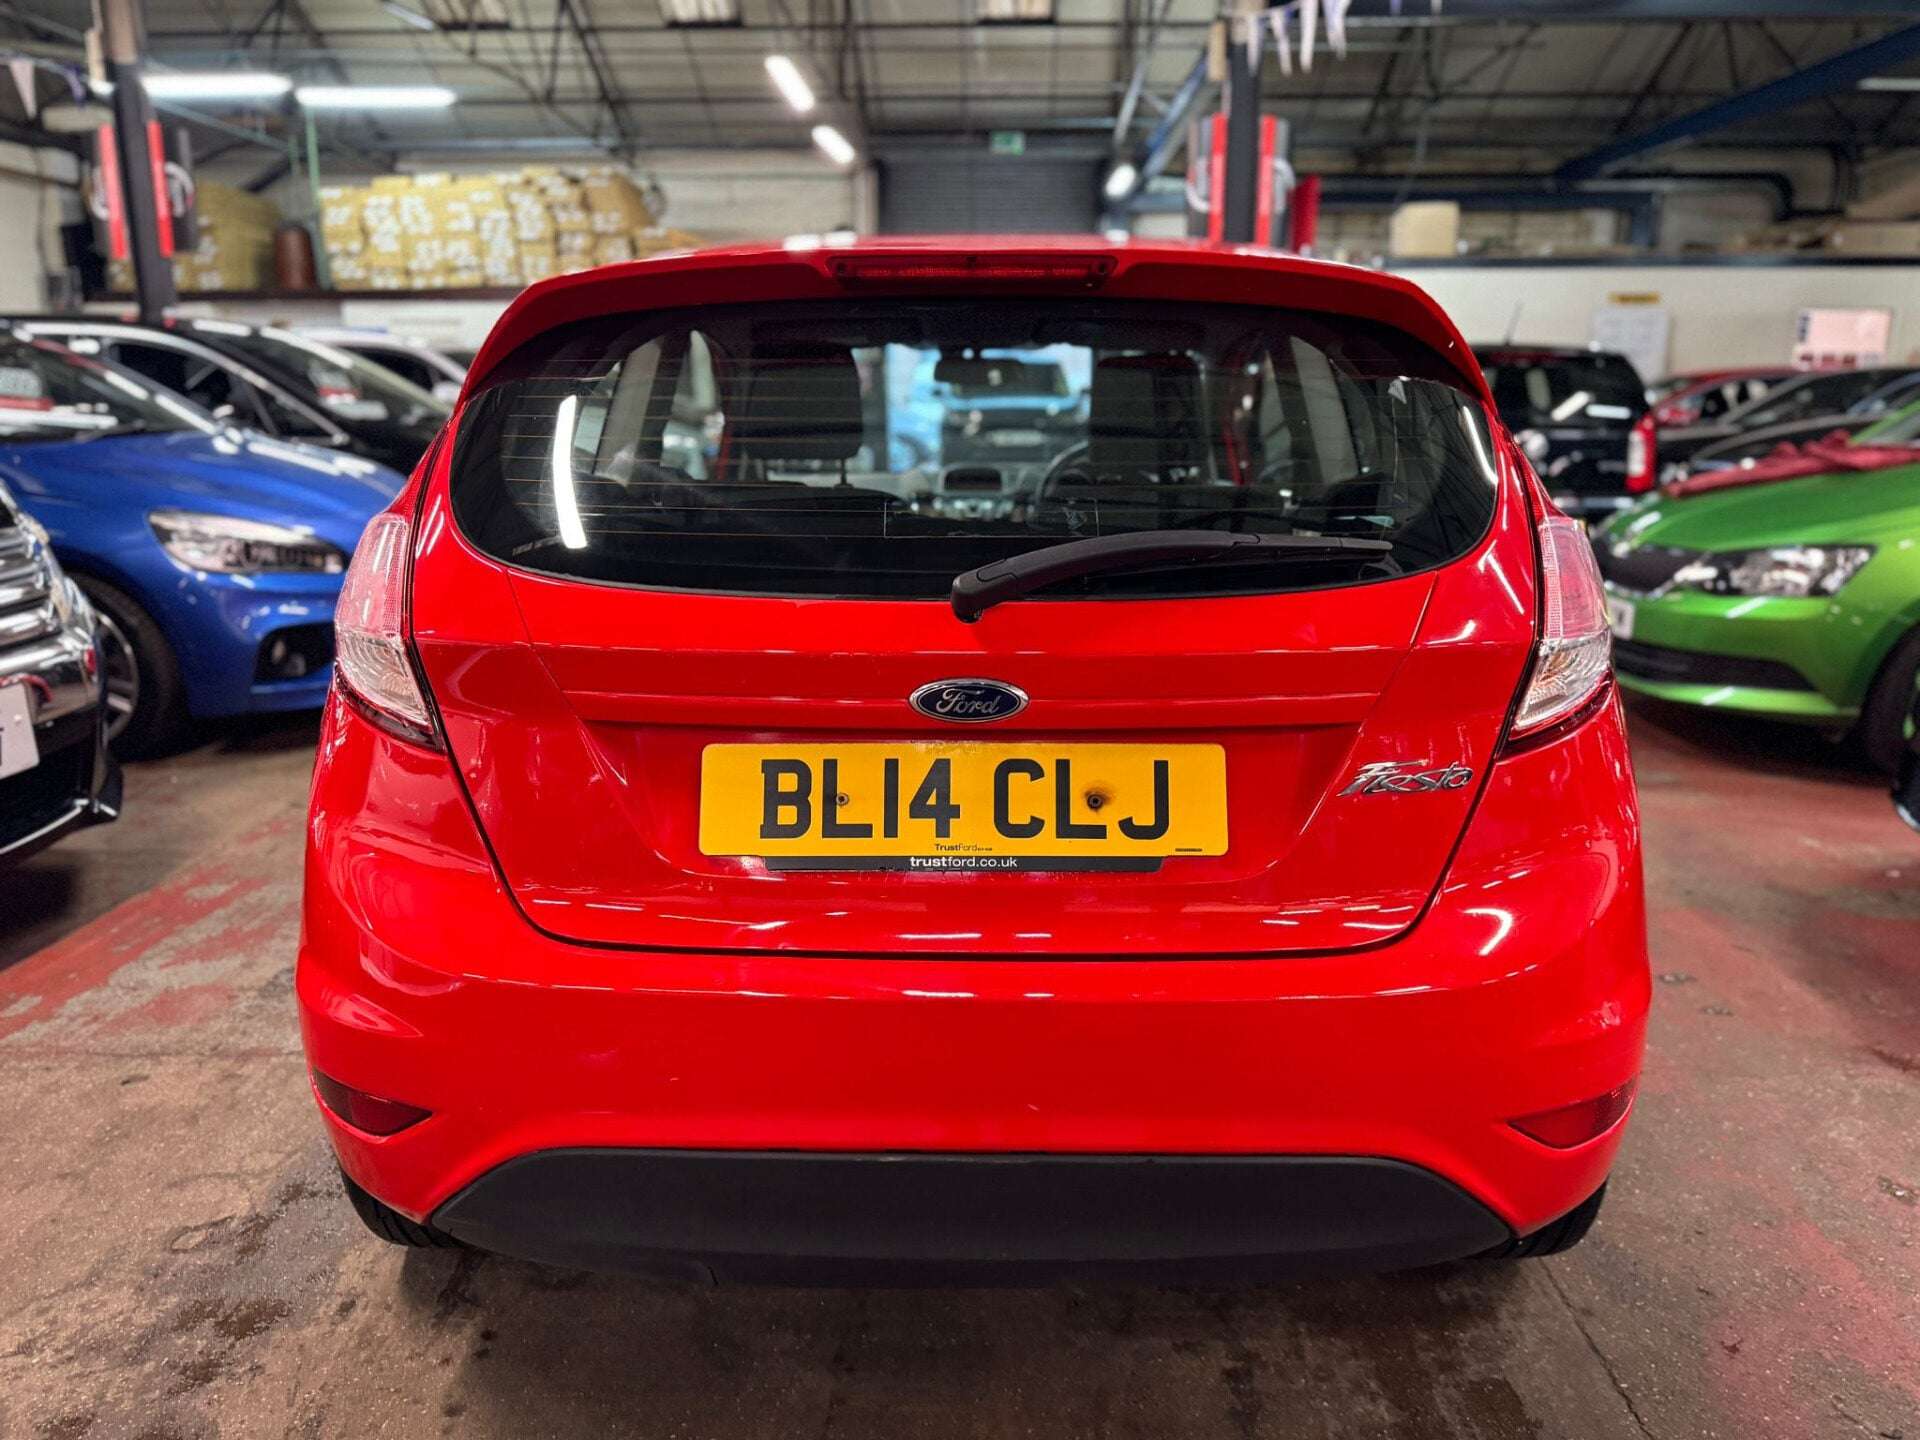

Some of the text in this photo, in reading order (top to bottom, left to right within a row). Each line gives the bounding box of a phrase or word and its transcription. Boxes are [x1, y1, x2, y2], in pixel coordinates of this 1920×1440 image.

[936, 688, 1001, 713] Ford
[1336, 759, 1473, 797] Fiesta
[760, 758, 1169, 840] BL14 CLJ
[910, 856, 1018, 868] trustford.co.uk
